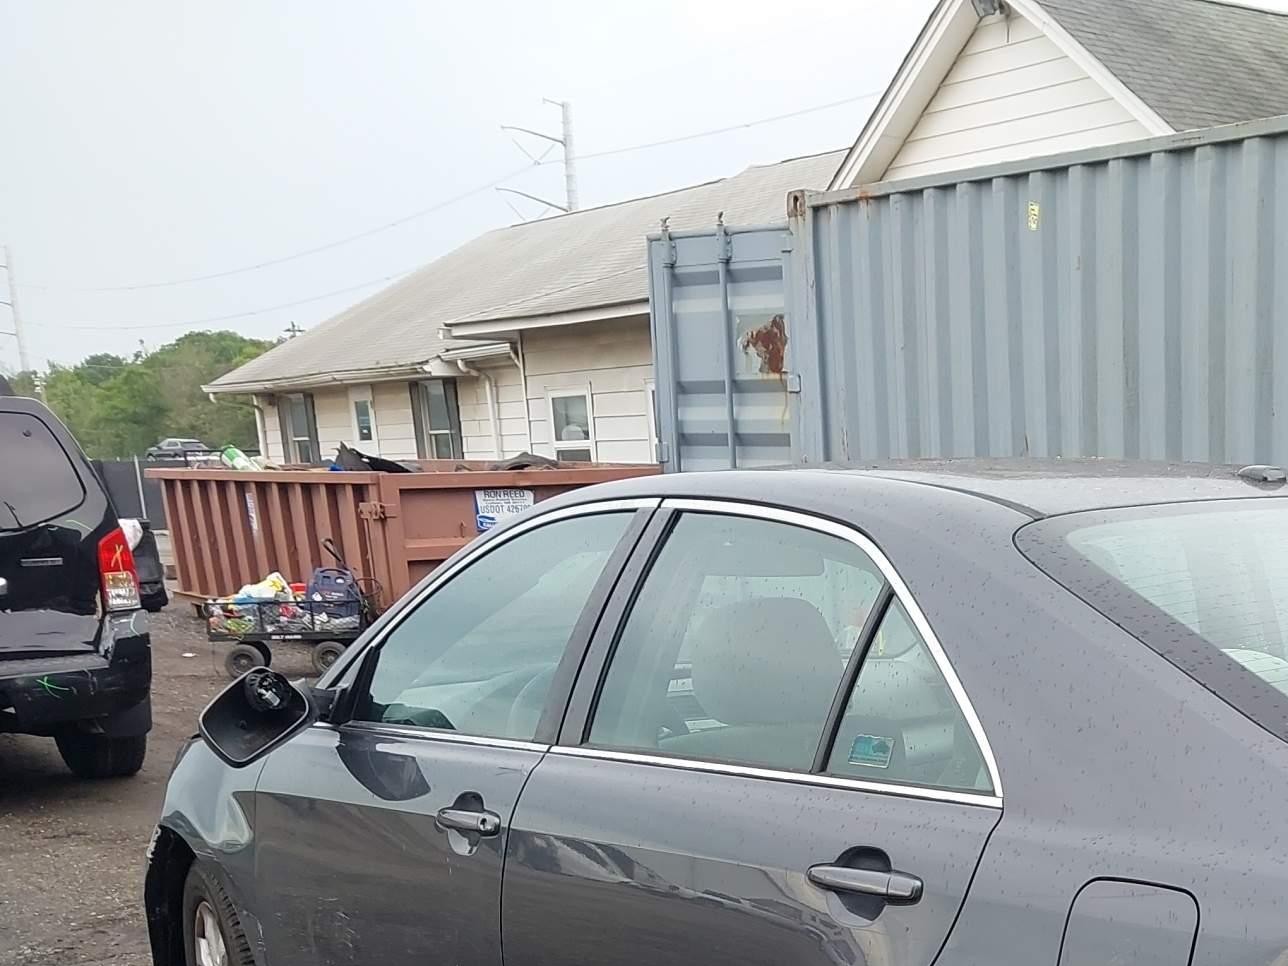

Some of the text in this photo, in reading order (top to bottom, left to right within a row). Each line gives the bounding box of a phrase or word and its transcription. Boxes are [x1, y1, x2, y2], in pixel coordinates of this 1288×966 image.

[483, 490, 525, 499] RON REED
[480, 505, 504, 514] USDOT
